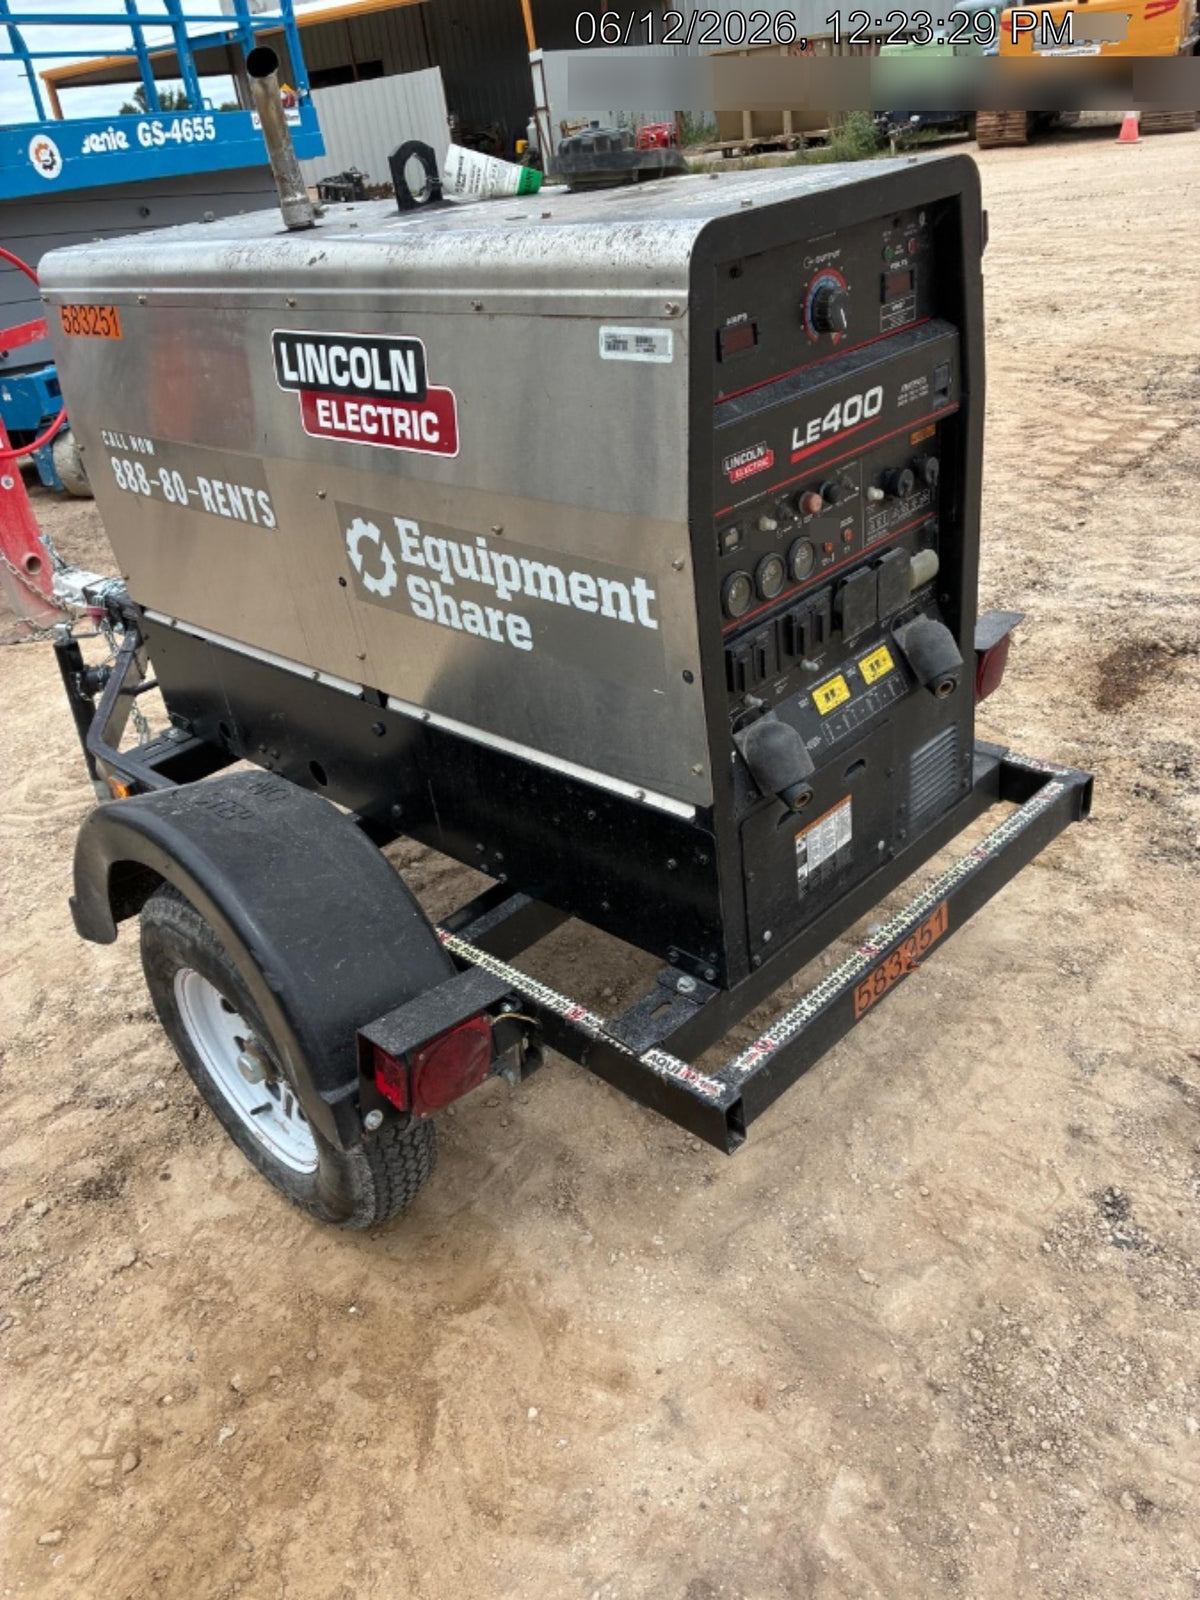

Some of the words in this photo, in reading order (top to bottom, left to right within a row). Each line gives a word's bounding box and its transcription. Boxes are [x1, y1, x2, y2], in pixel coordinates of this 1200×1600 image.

[137, 116, 216, 147] GS-4655
[61, 304, 121, 338] 583251
[280, 342, 417, 394] LINCOLN
[316, 399, 440, 443] ELECTRIC
[791, 385, 883, 450] LE400
[101, 430, 129, 450] CALL
[131, 436, 155, 456] NOW
[725, 445, 765, 473] LINCOLN
[111, 456, 277, 529] 888-80-RENTS
[393, 517, 659, 630] Equipment
[406, 573, 534, 651] Share
[769, 1023, 788, 1042] DO
[785, 1004, 809, 1027] NOT
[646, 1051, 681, 1075] AQUI
